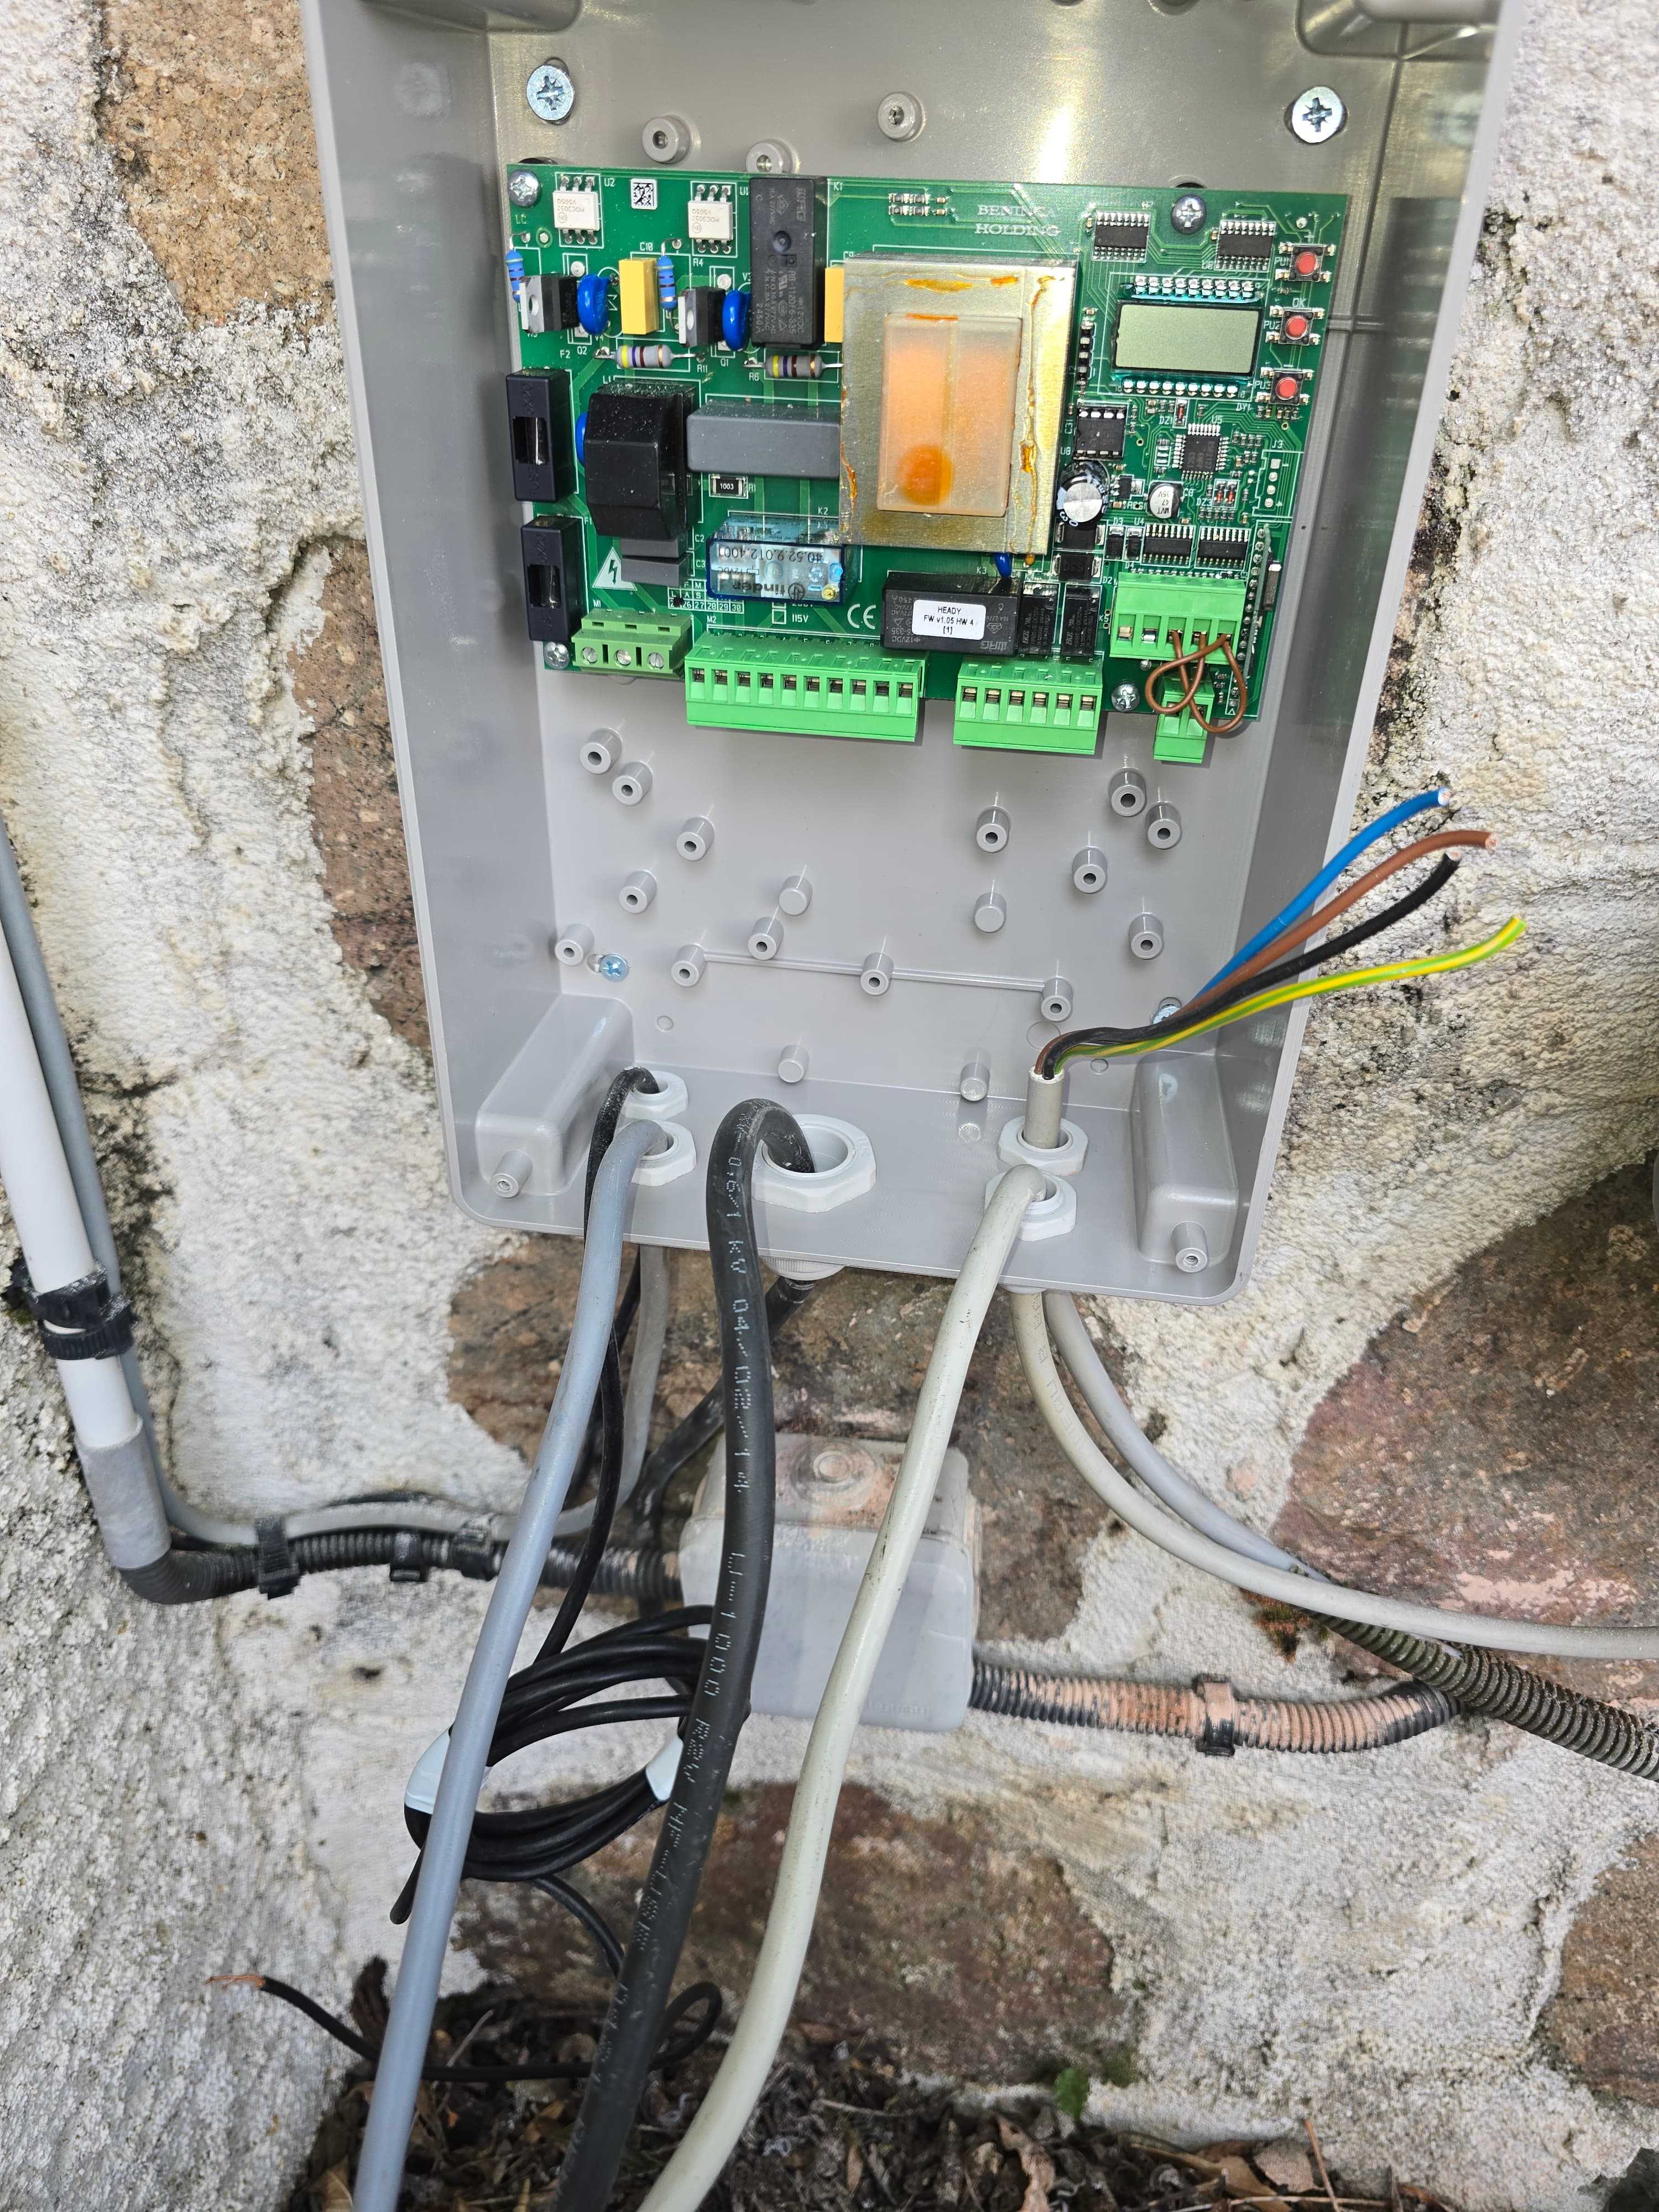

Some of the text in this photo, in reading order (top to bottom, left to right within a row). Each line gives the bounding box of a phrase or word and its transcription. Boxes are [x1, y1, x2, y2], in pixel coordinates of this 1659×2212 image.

[604, 178, 615, 187] U2
[833, 181, 843, 191] K1
[691, 215, 720, 223] MOC3052
[974, 223, 1061, 237] HOLDING
[640, 242, 653, 251] C10
[693, 258, 703, 267] R4
[1292, 298, 1306, 307] OK
[1264, 321, 1281, 330] PU2
[560, 350, 571, 358] F2
[577, 346, 587, 355] Q2
[749, 373, 759, 381] R6
[1159, 416, 1173, 425] DZ1
[1211, 416, 1223, 424] U5
[1272, 440, 1284, 448] J3
[818, 507, 828, 515] K2
[695, 534, 705, 542] C2
[696, 560, 706, 568] C3
[976, 566, 987, 575] K3
[1103, 576, 1113, 585] D2
[593, 599, 601, 608] M1
[937, 606, 961, 615] HEADY
[707, 615, 717, 624] M2
[792, 614, 809, 623] 115V
[1099, 614, 1109, 623] K5
[943, 626, 953, 635] [1]
[704, 1551, 745, 1697] U-1000
